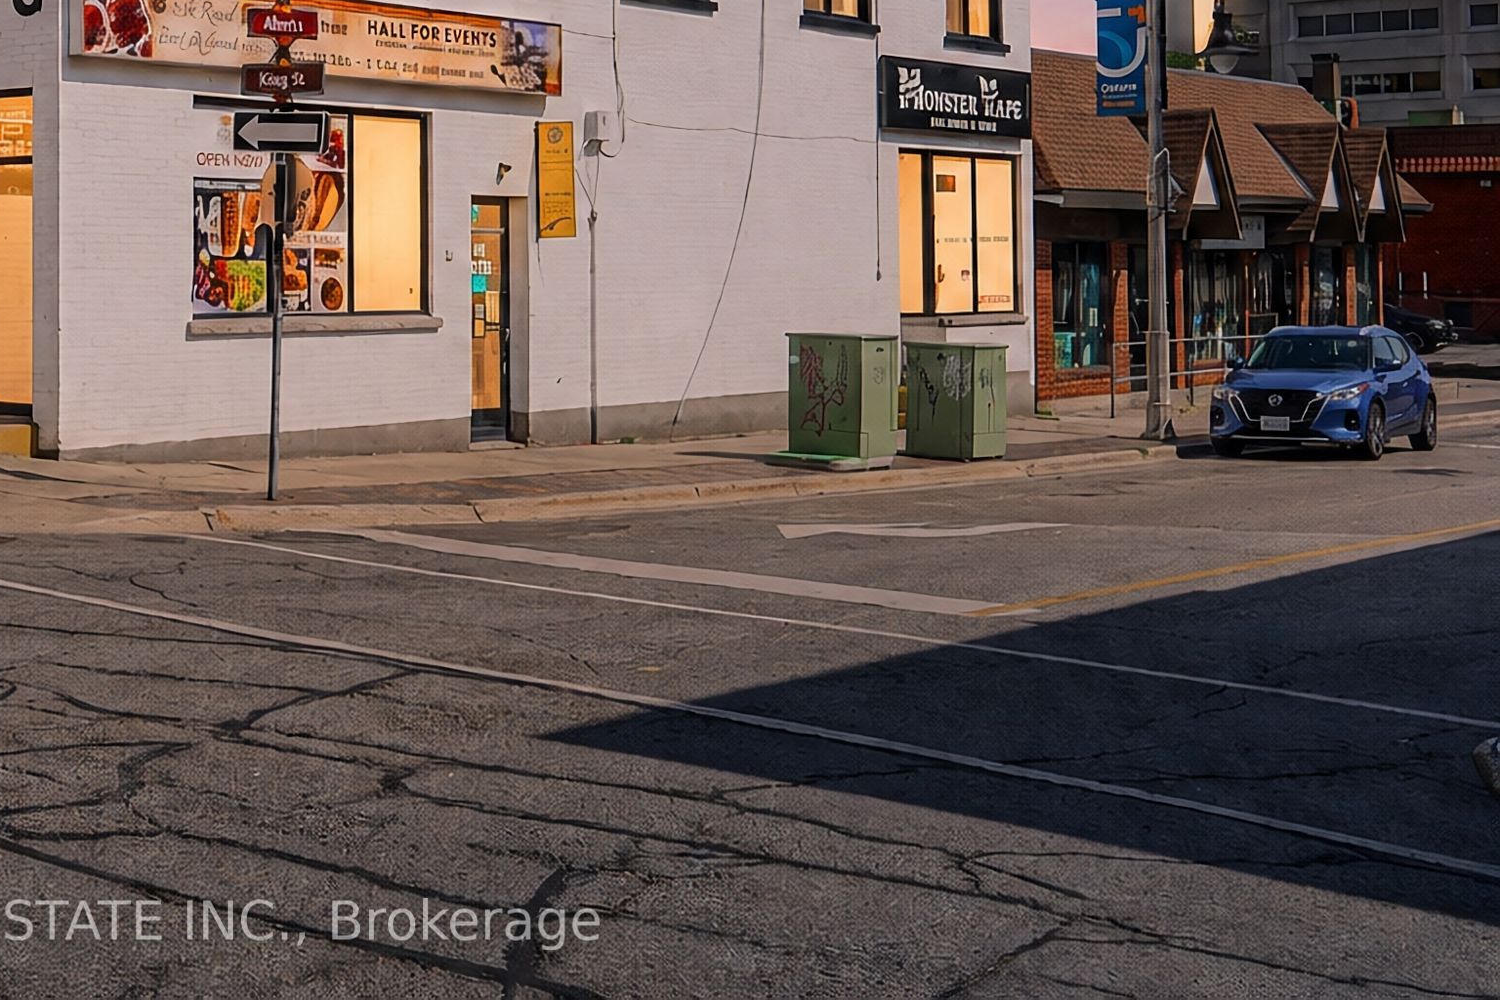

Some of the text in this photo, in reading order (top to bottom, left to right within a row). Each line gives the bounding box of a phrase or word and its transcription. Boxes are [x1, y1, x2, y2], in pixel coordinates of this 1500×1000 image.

[367, 19, 406, 39] HALL
[411, 23, 440, 41] FOR
[445, 27, 497, 48] EVENTS
